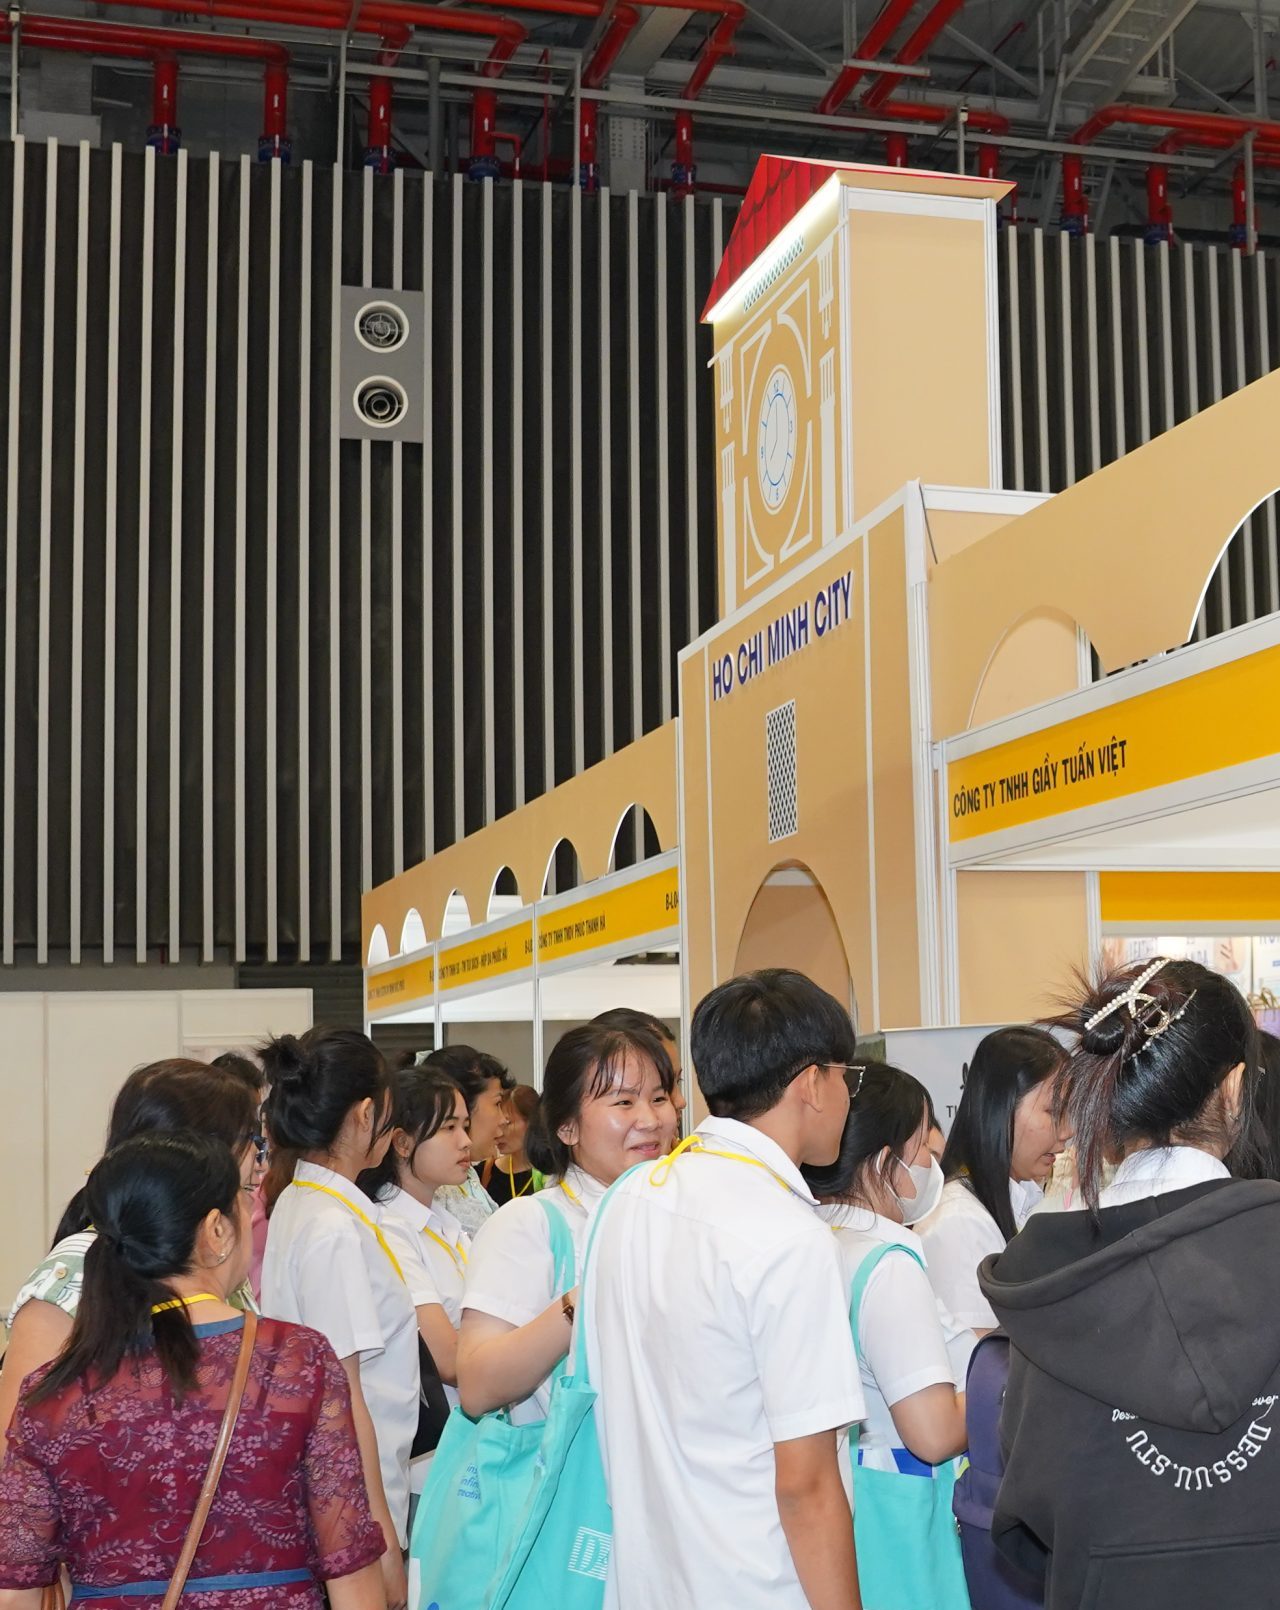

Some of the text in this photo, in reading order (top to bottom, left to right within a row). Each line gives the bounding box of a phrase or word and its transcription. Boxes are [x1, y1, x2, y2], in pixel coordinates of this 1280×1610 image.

[713, 570, 852, 701] HO CHI MINH CITY
[953, 785, 980, 817] CÔNG
[983, 781, 996, 808] TY
[999, 771, 1029, 804] TNHH
[1062, 741, 1094, 785] TUẤN
[1098, 735, 1127, 776] VIỆT
